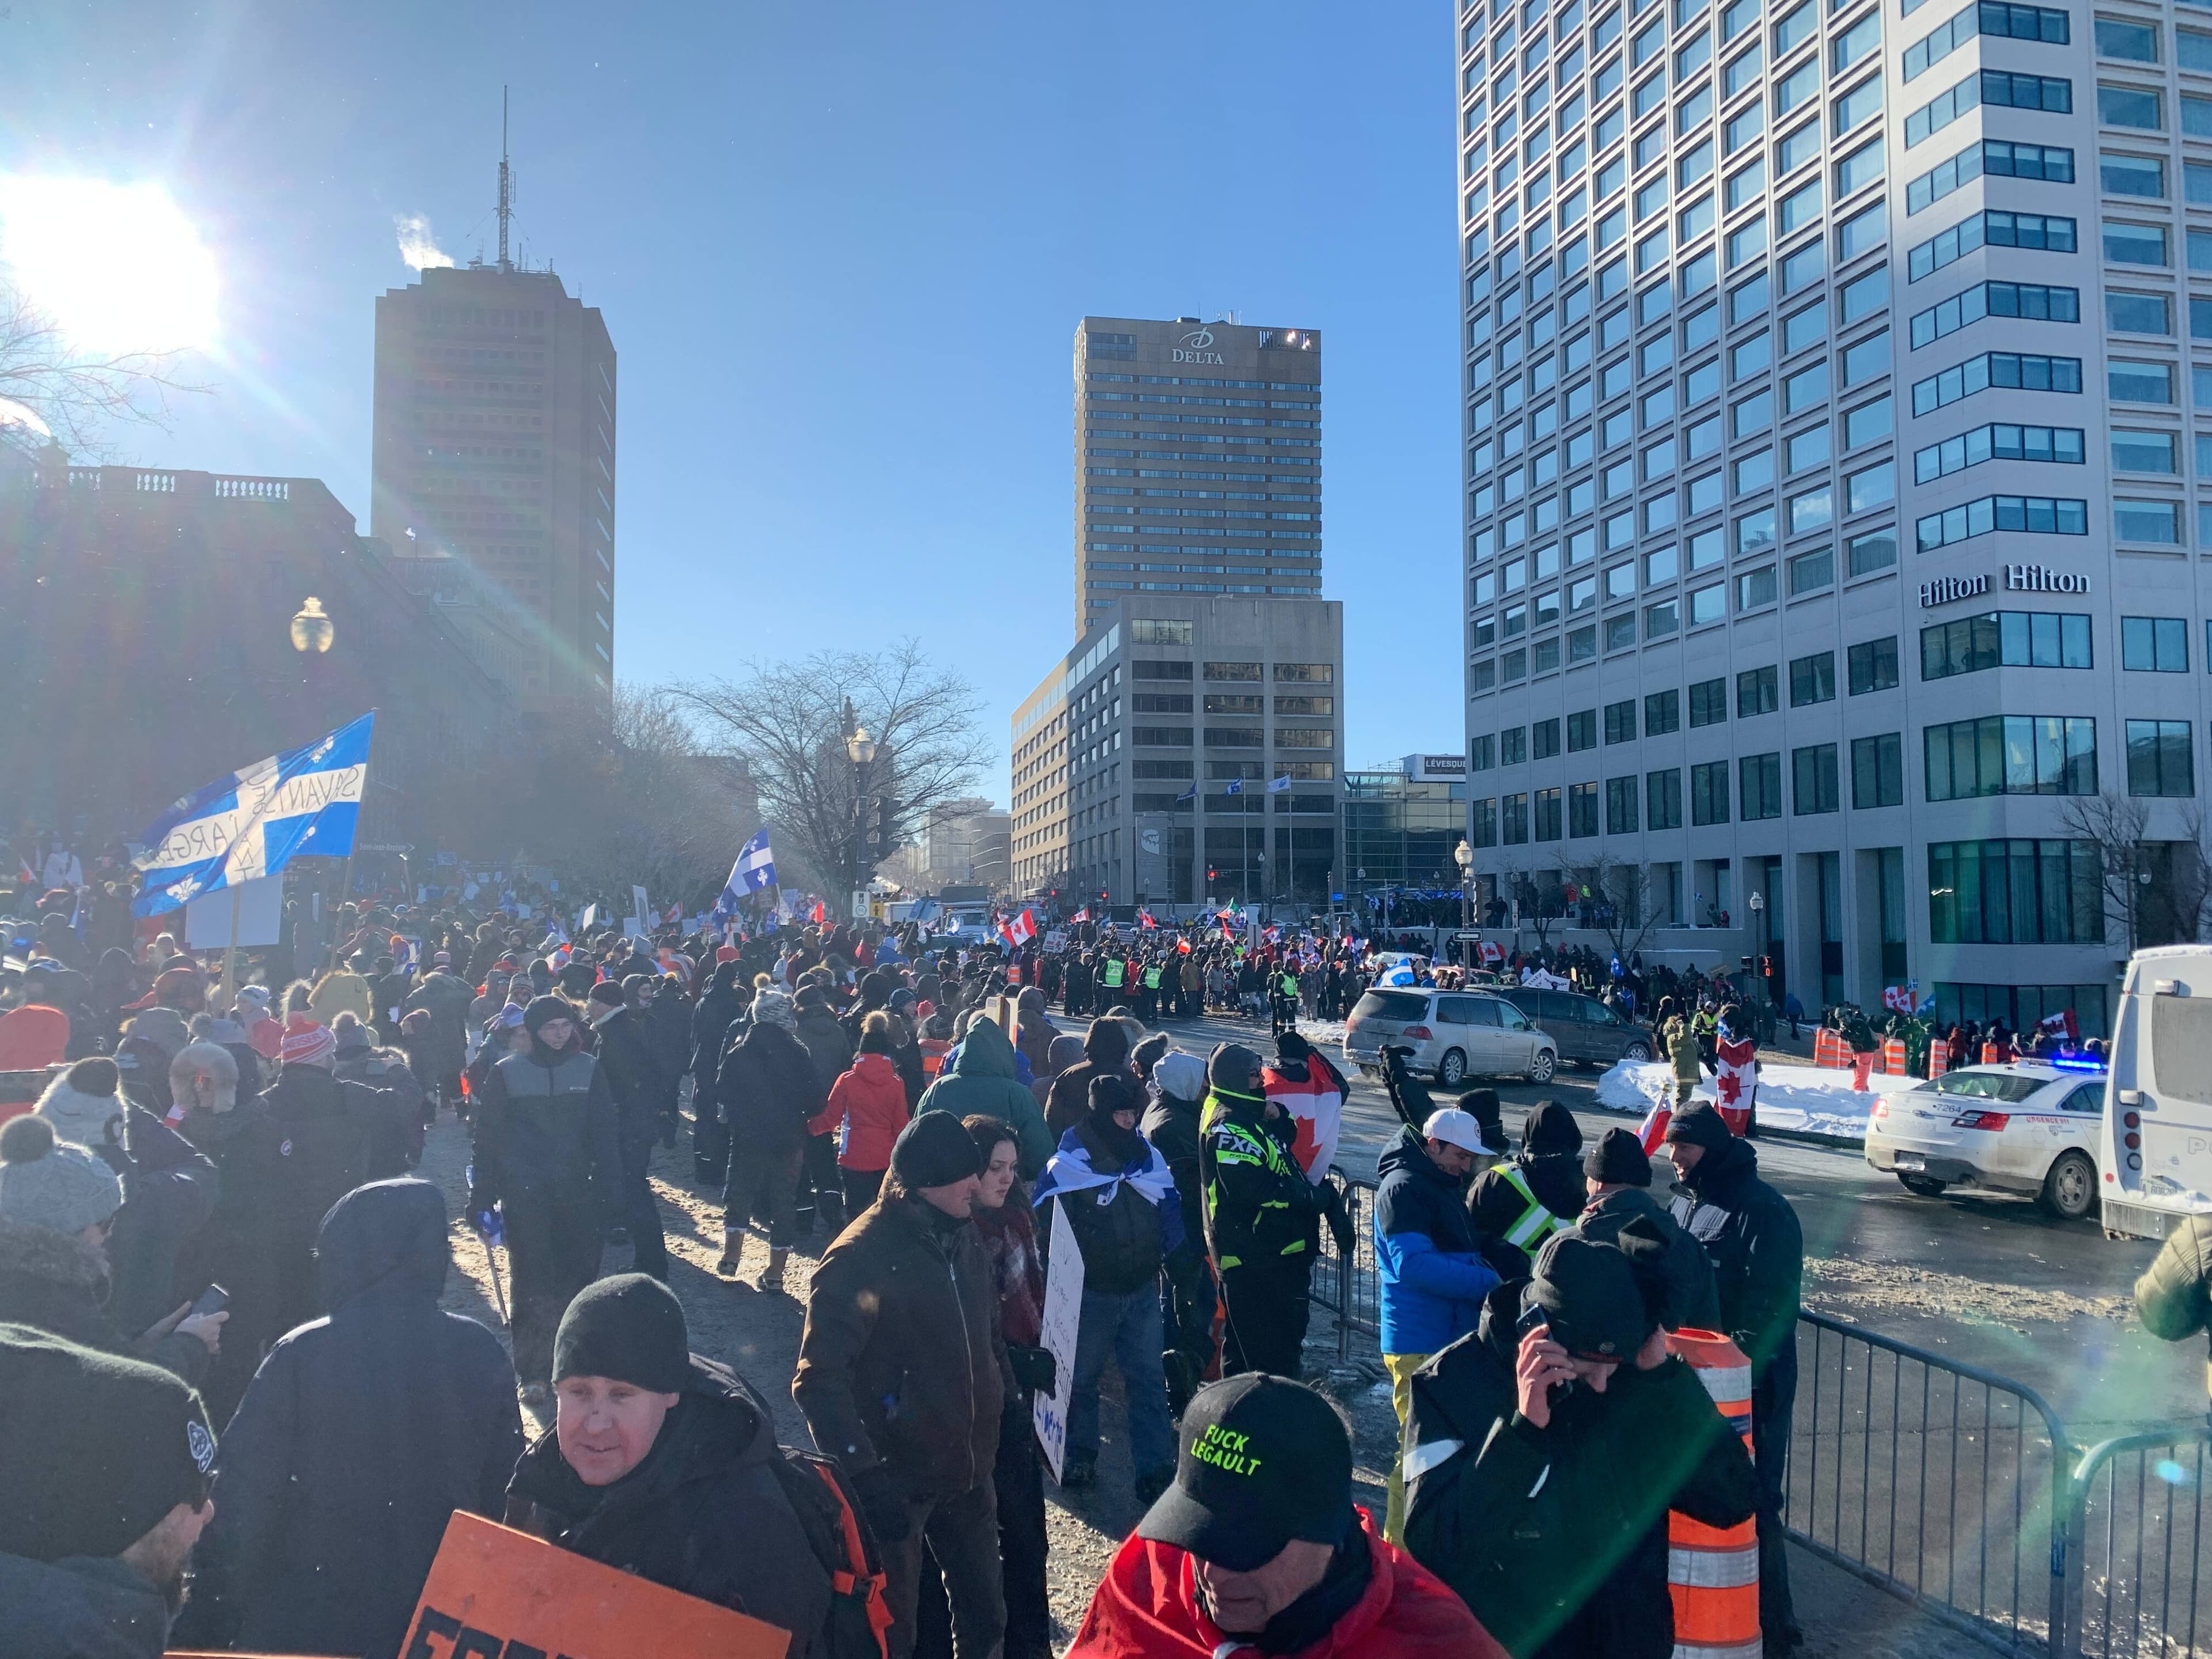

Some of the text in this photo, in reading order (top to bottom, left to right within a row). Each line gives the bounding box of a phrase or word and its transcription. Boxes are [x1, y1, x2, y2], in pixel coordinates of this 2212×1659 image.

[1172, 349, 1224, 365] DELTA
[1917, 574, 1987, 608] Hilton
[2007, 565, 2091, 593] Hilton
[1426, 759, 1465, 768] LÉVESQUE
[1937, 1104, 1961, 1113] 7264
[1217, 1134, 1262, 1158] FXR
[2188, 1136, 2212, 1157] P
[1205, 1424, 1249, 1453] FUCK
[1191, 1438, 1262, 1476] LEGAULT
